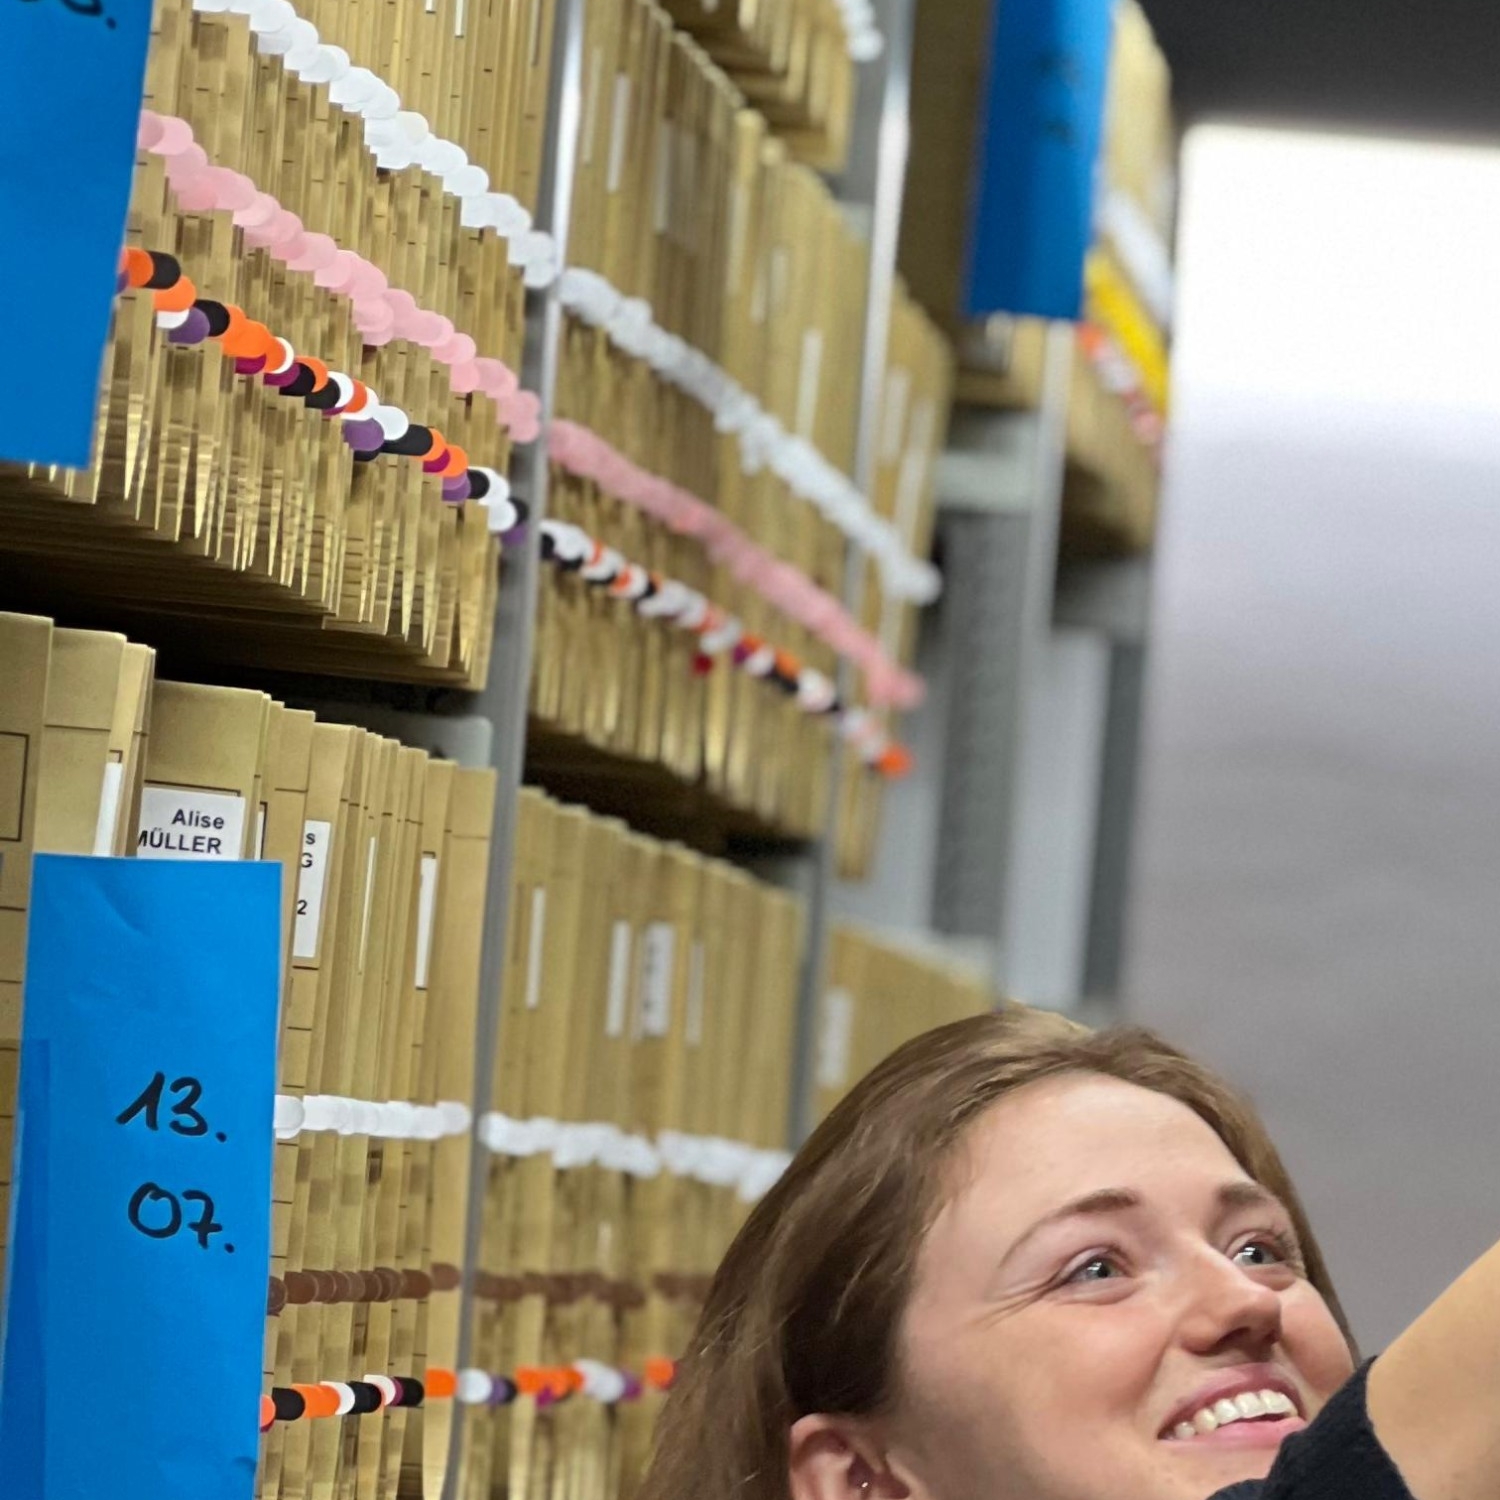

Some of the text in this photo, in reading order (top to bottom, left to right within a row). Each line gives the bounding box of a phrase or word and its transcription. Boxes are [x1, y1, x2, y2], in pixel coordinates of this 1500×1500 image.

[171, 808, 225, 829] Alise
[116, 1071, 227, 1143] 13.
[128, 1182, 235, 1253] 07.
